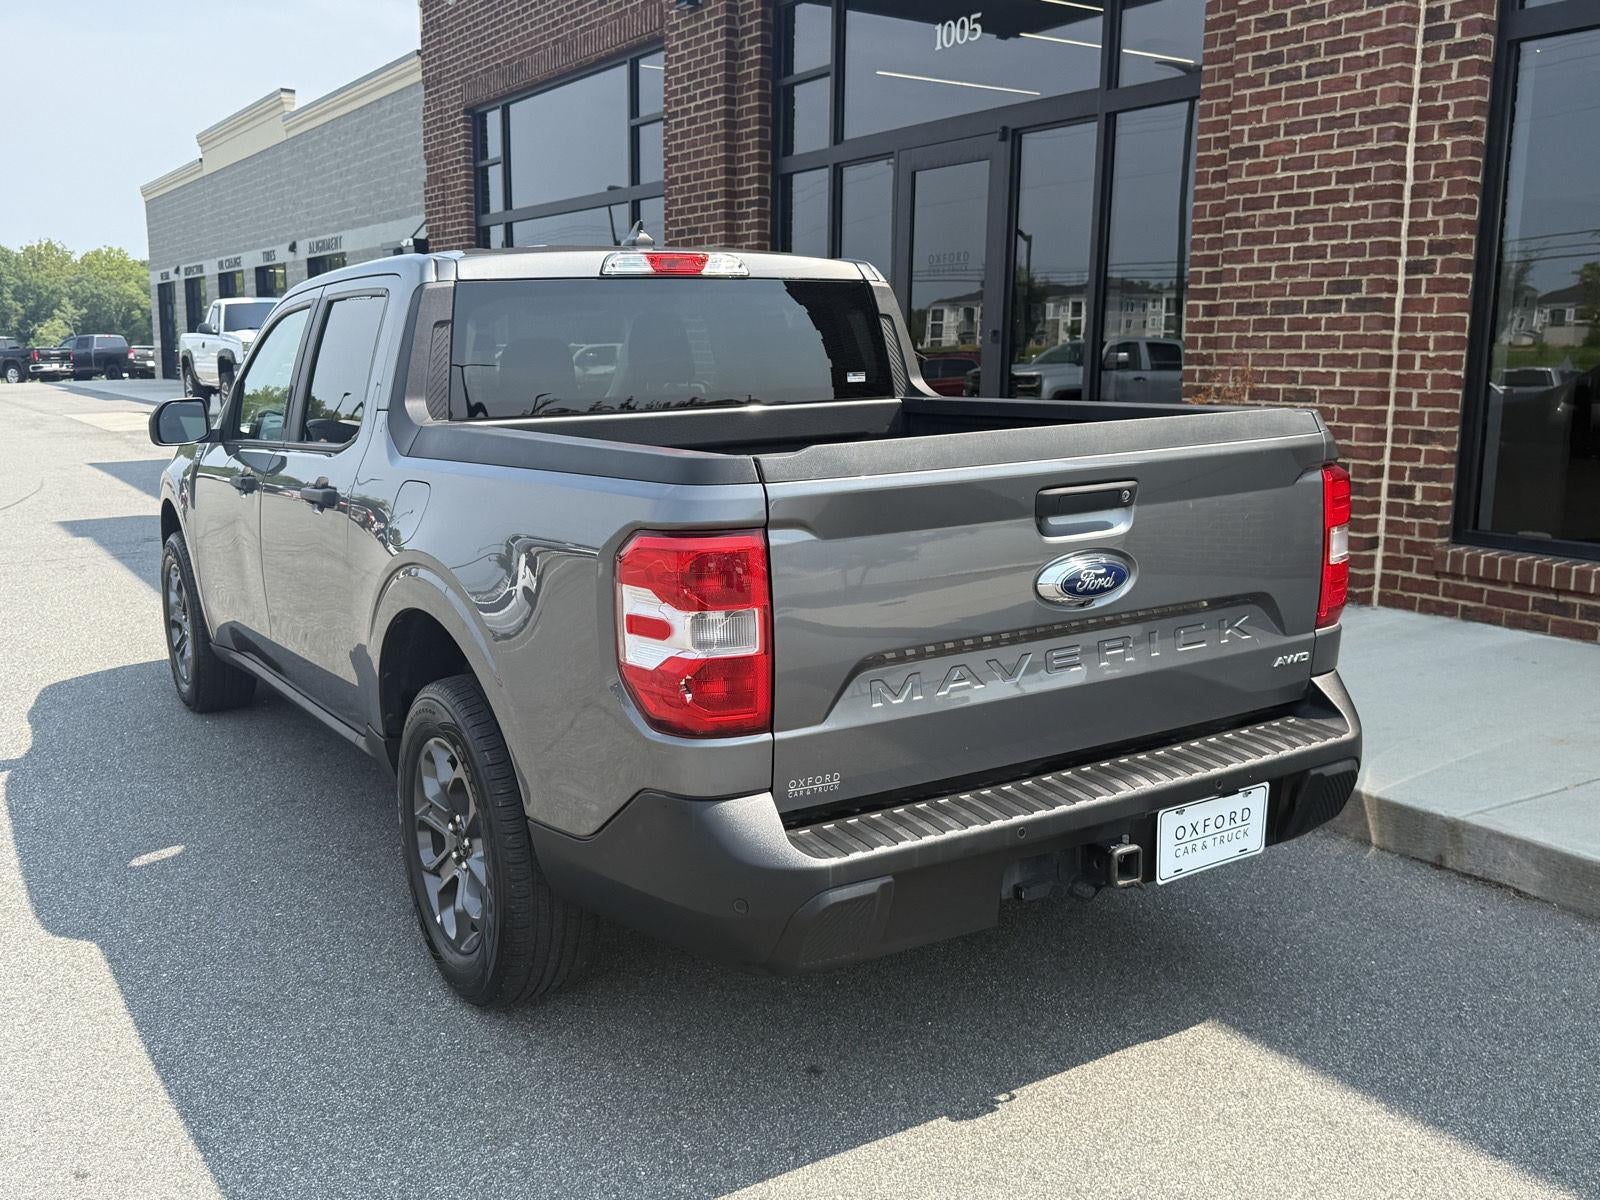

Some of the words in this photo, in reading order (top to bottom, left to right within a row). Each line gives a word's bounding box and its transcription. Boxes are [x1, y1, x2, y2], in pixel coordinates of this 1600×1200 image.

[935, 11, 982, 51] 1005
[308, 235, 343, 255] ALIGNMENT
[927, 251, 970, 265] OXFORD
[1076, 567, 1116, 592] Ford
[869, 614, 1252, 707] MAVERICK
[1273, 651, 1309, 668] AWD
[788, 772, 840, 789] OXFORD
[813, 784, 839, 794] TRUCK
[1174, 807, 1252, 841] OXFORD
[1174, 843, 1197, 859] CAR
[1201, 840, 1208, 851] &
[1211, 827, 1250, 847] TRUCK
